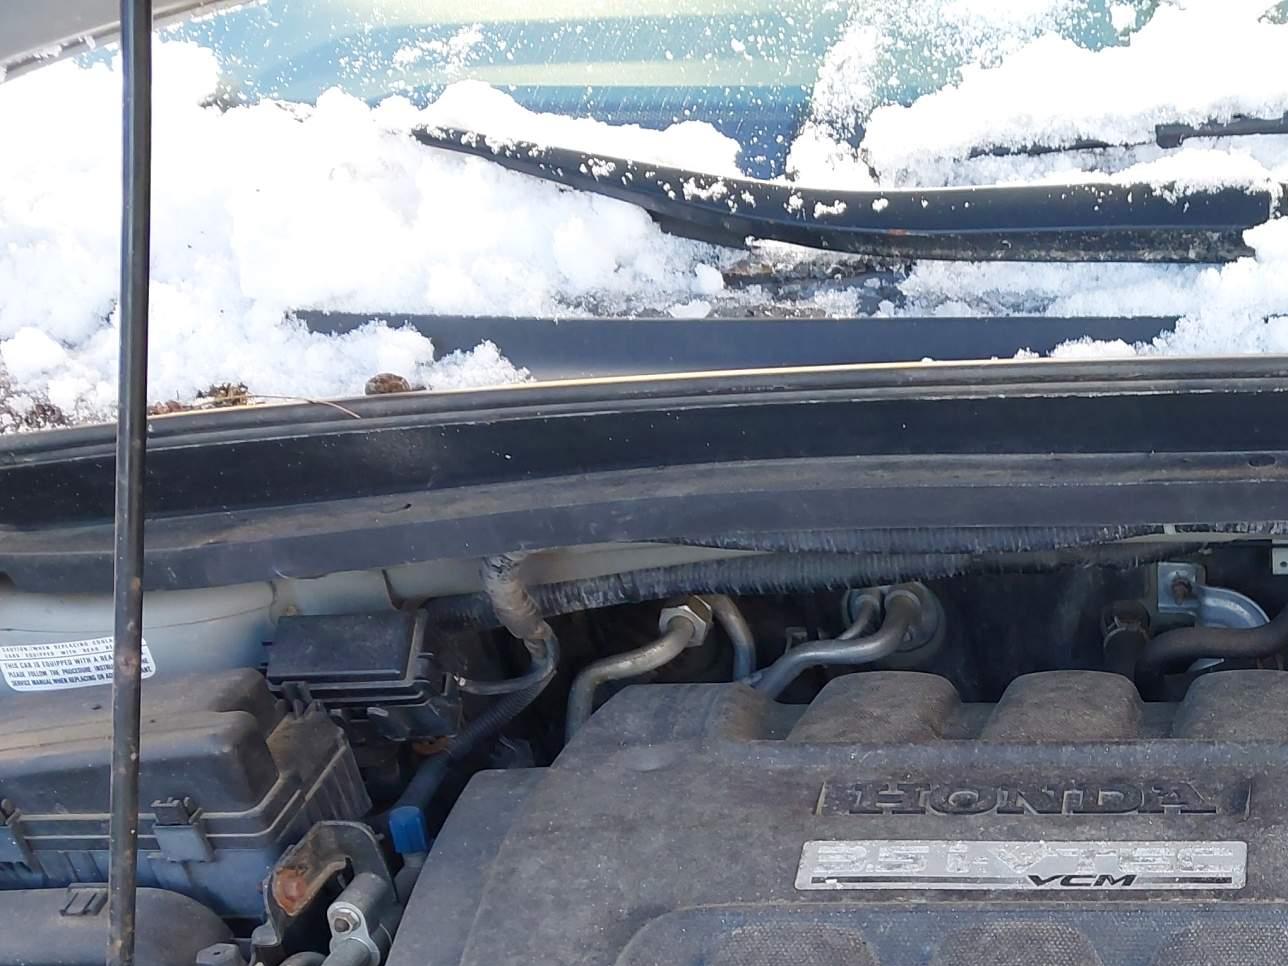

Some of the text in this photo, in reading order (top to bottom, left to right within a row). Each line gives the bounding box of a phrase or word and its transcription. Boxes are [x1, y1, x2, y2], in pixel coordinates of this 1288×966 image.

[42, 658, 73, 668] EQUIPPED
[74, 657, 91, 665] WITH
[848, 781, 1219, 816] HONDA
[1027, 874, 1138, 888] VCM
